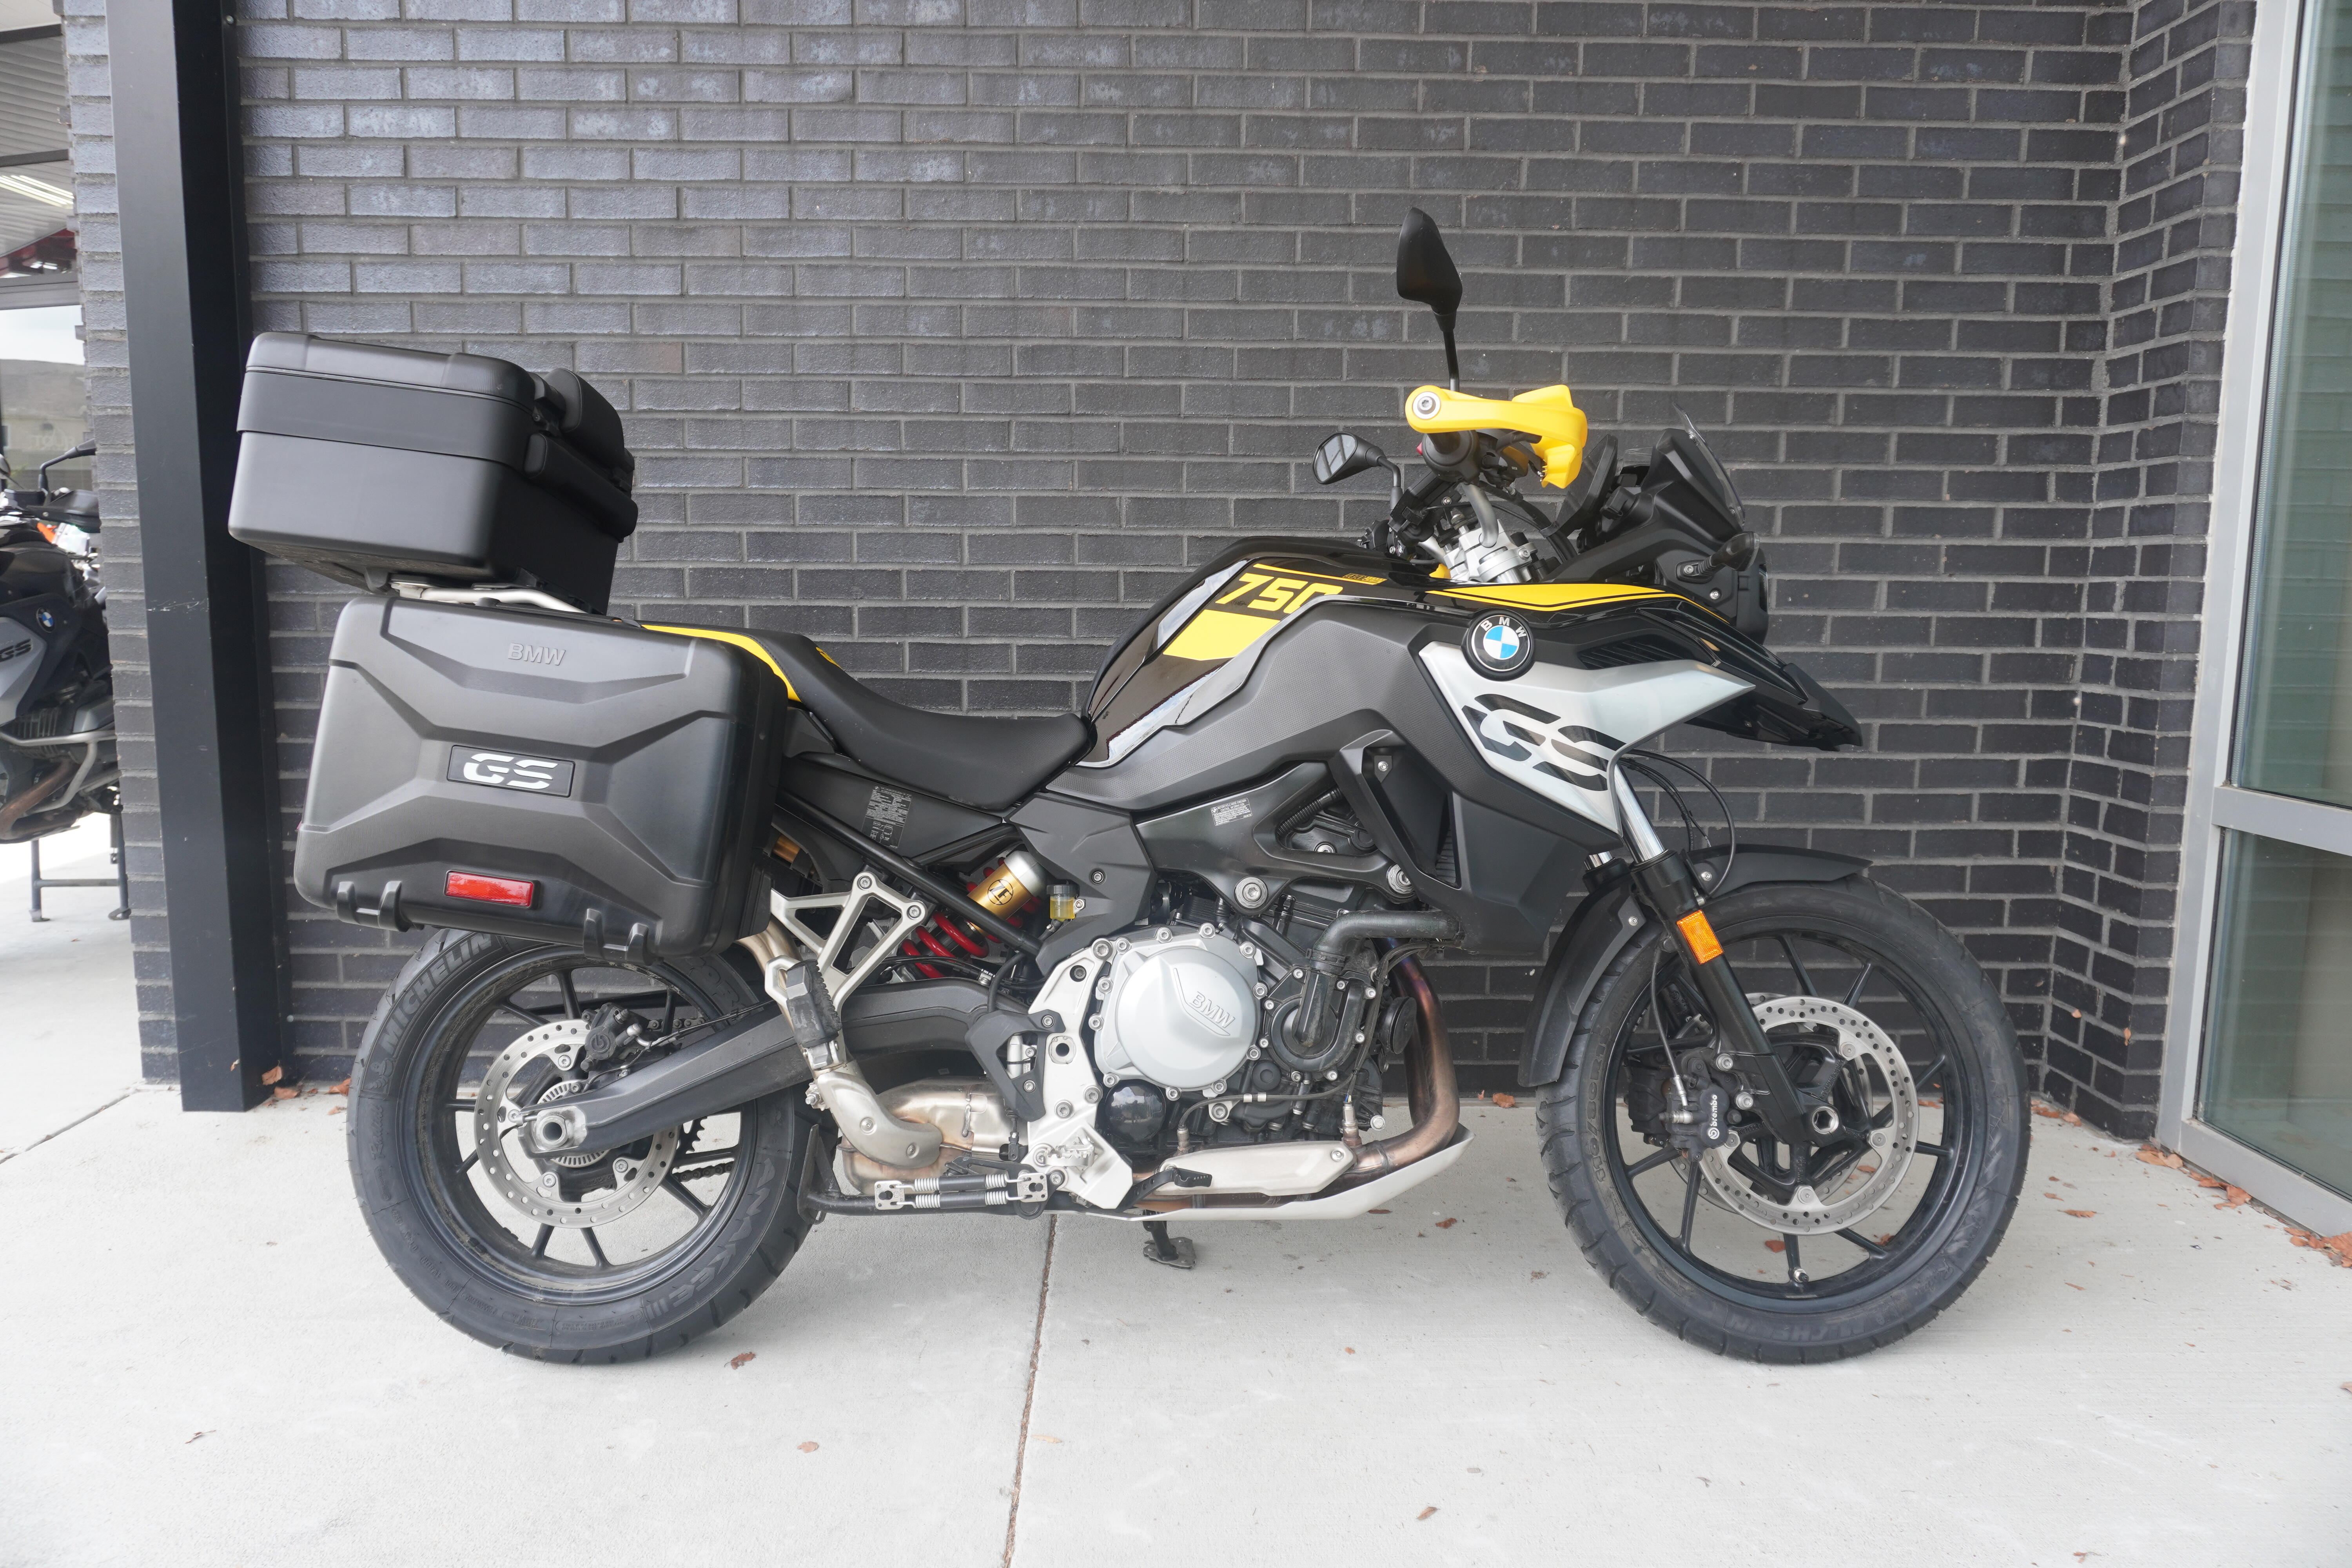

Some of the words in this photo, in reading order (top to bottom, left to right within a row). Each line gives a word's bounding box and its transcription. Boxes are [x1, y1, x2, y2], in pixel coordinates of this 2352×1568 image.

[1480, 617, 1526, 637] BMW
[508, 643, 566, 666] BMW
[1462, 694, 1627, 791] GS
[464, 753, 558, 789] GS
[988, 880, 1013, 904] ZF
[378, 933, 492, 1056] MICHELIN
[1190, 991, 1236, 1028] BMW
[669, 1158, 776, 1308] ANAKEE
